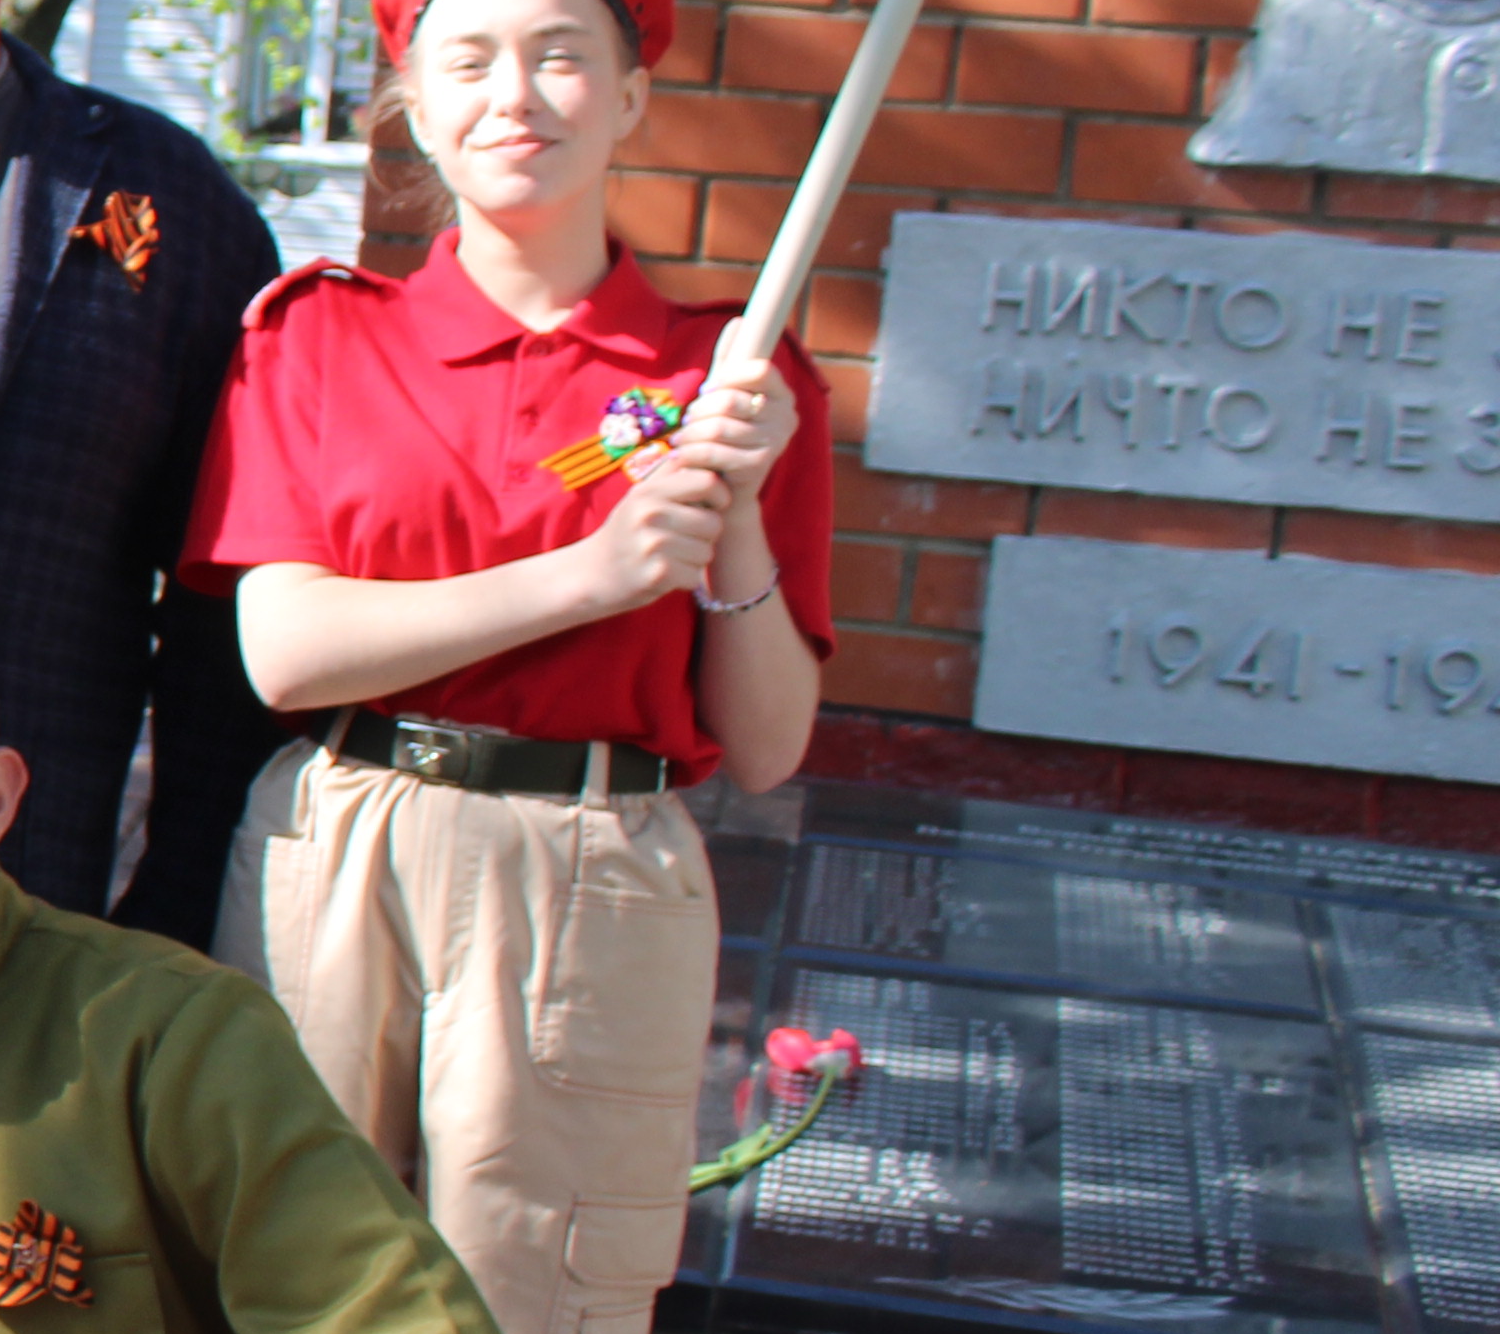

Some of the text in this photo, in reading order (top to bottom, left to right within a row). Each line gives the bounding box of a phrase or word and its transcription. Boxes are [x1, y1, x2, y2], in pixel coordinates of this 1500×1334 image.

[980, 261, 1446, 366] НИКТО НЕ
[971, 357, 1278, 452] НИЧТО
[1315, 389, 1436, 469] НЕ
[1106, 610, 1500, 716] 1941-19
